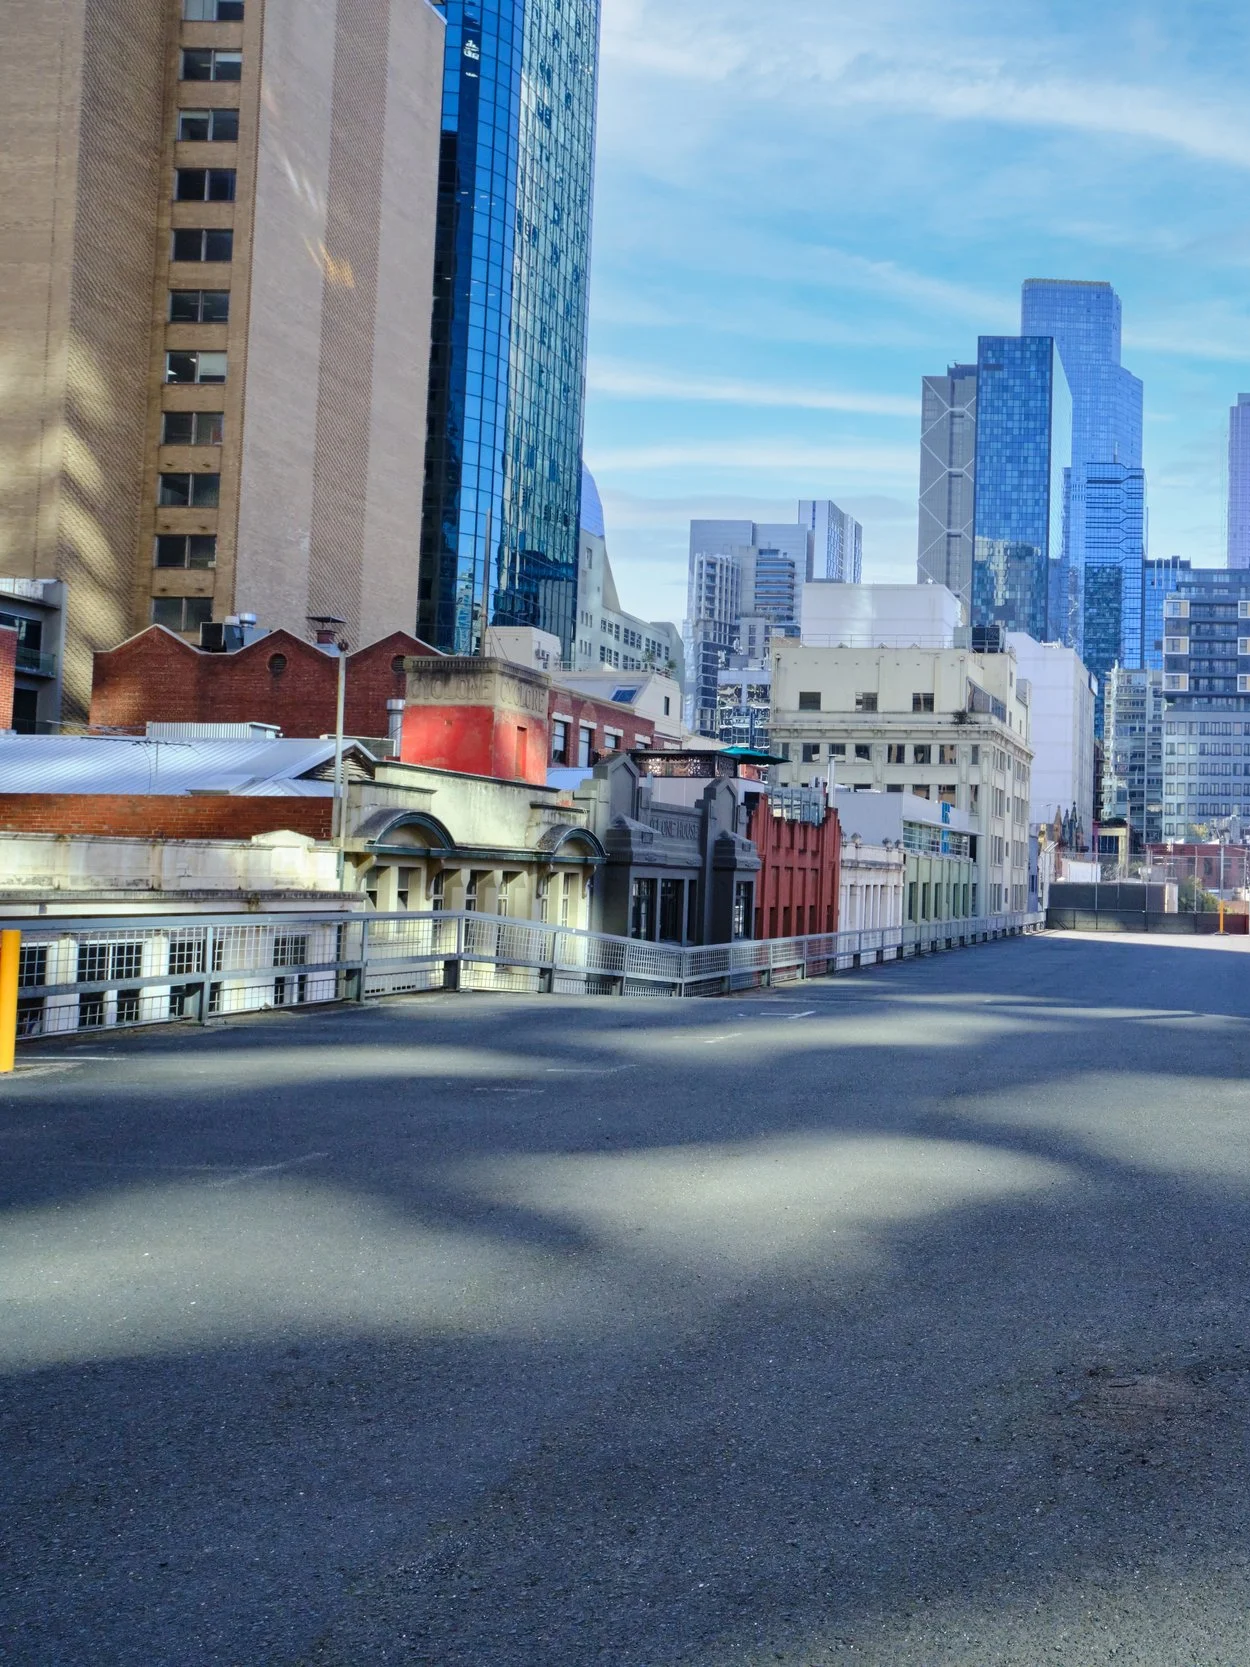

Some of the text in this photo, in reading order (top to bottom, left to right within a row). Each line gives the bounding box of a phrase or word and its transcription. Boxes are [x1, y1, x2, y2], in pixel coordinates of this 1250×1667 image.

[408, 678, 492, 700] CYCLONE
[500, 680, 545, 713] CYCLONE
[676, 820, 699, 841] HOUSE
